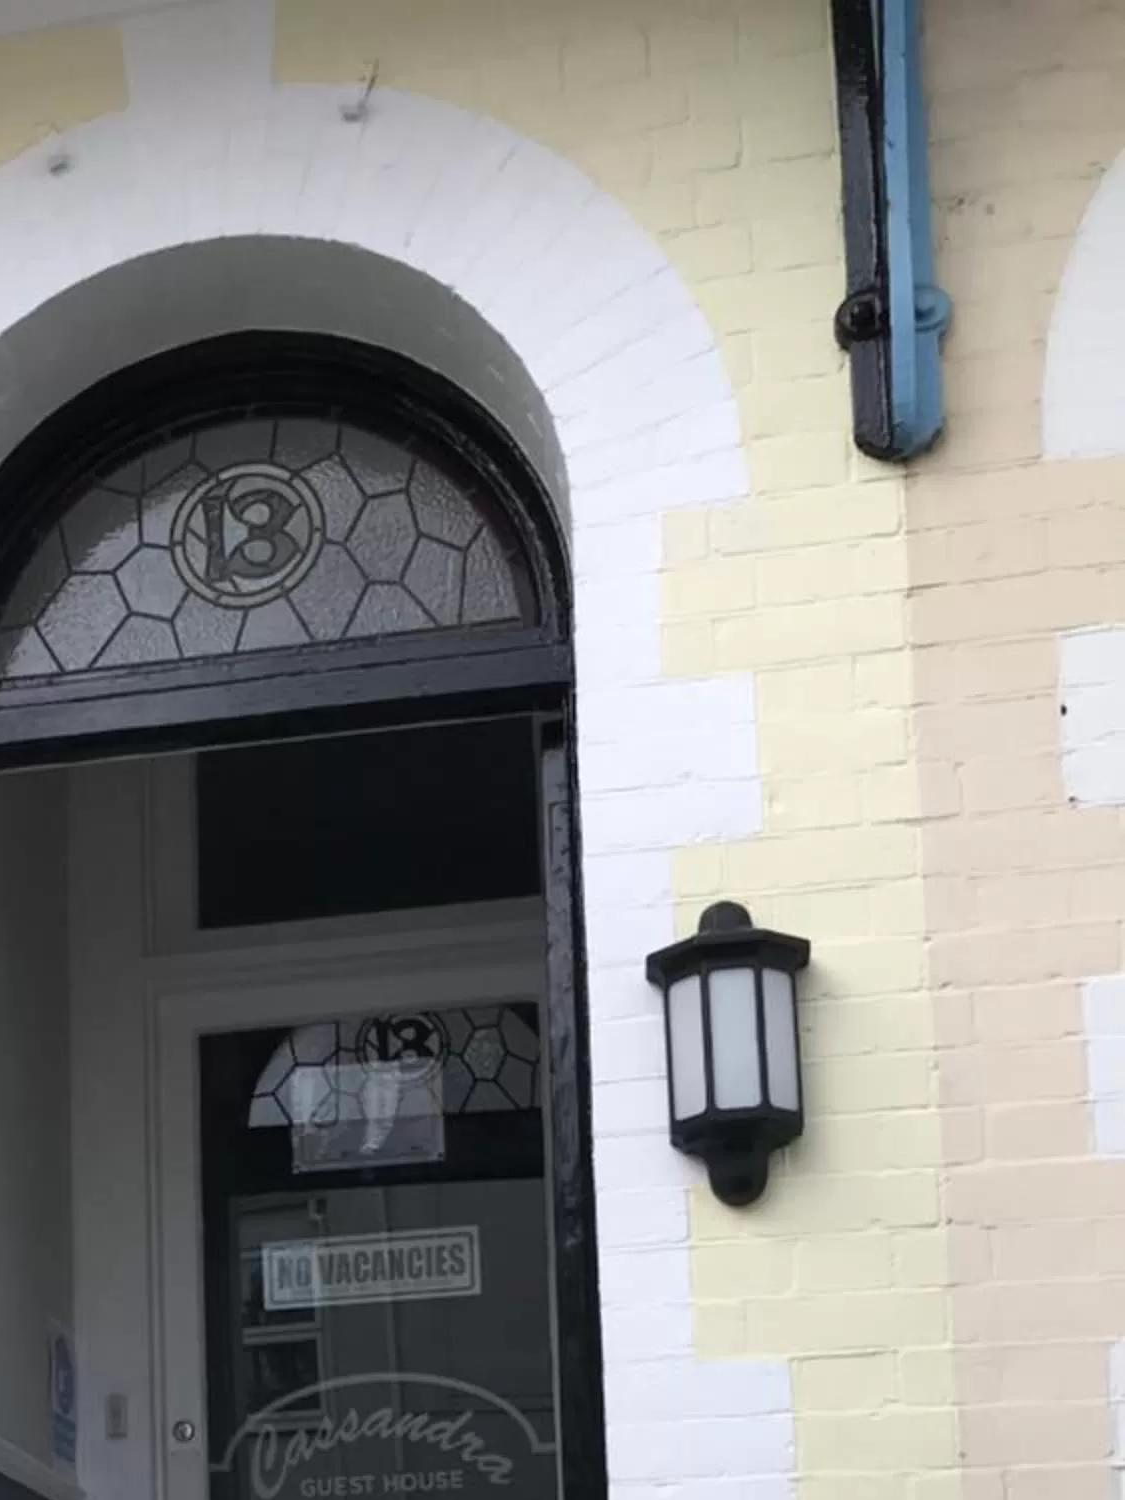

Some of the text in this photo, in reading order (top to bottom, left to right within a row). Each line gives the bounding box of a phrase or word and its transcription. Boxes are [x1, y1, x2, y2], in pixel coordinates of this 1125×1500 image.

[277, 1255, 312, 1290] NO
[318, 1243, 467, 1285] VACANCIES
[251, 1407, 515, 1500] Cassandra
[299, 1469, 465, 1499] GUEST HOUSE
